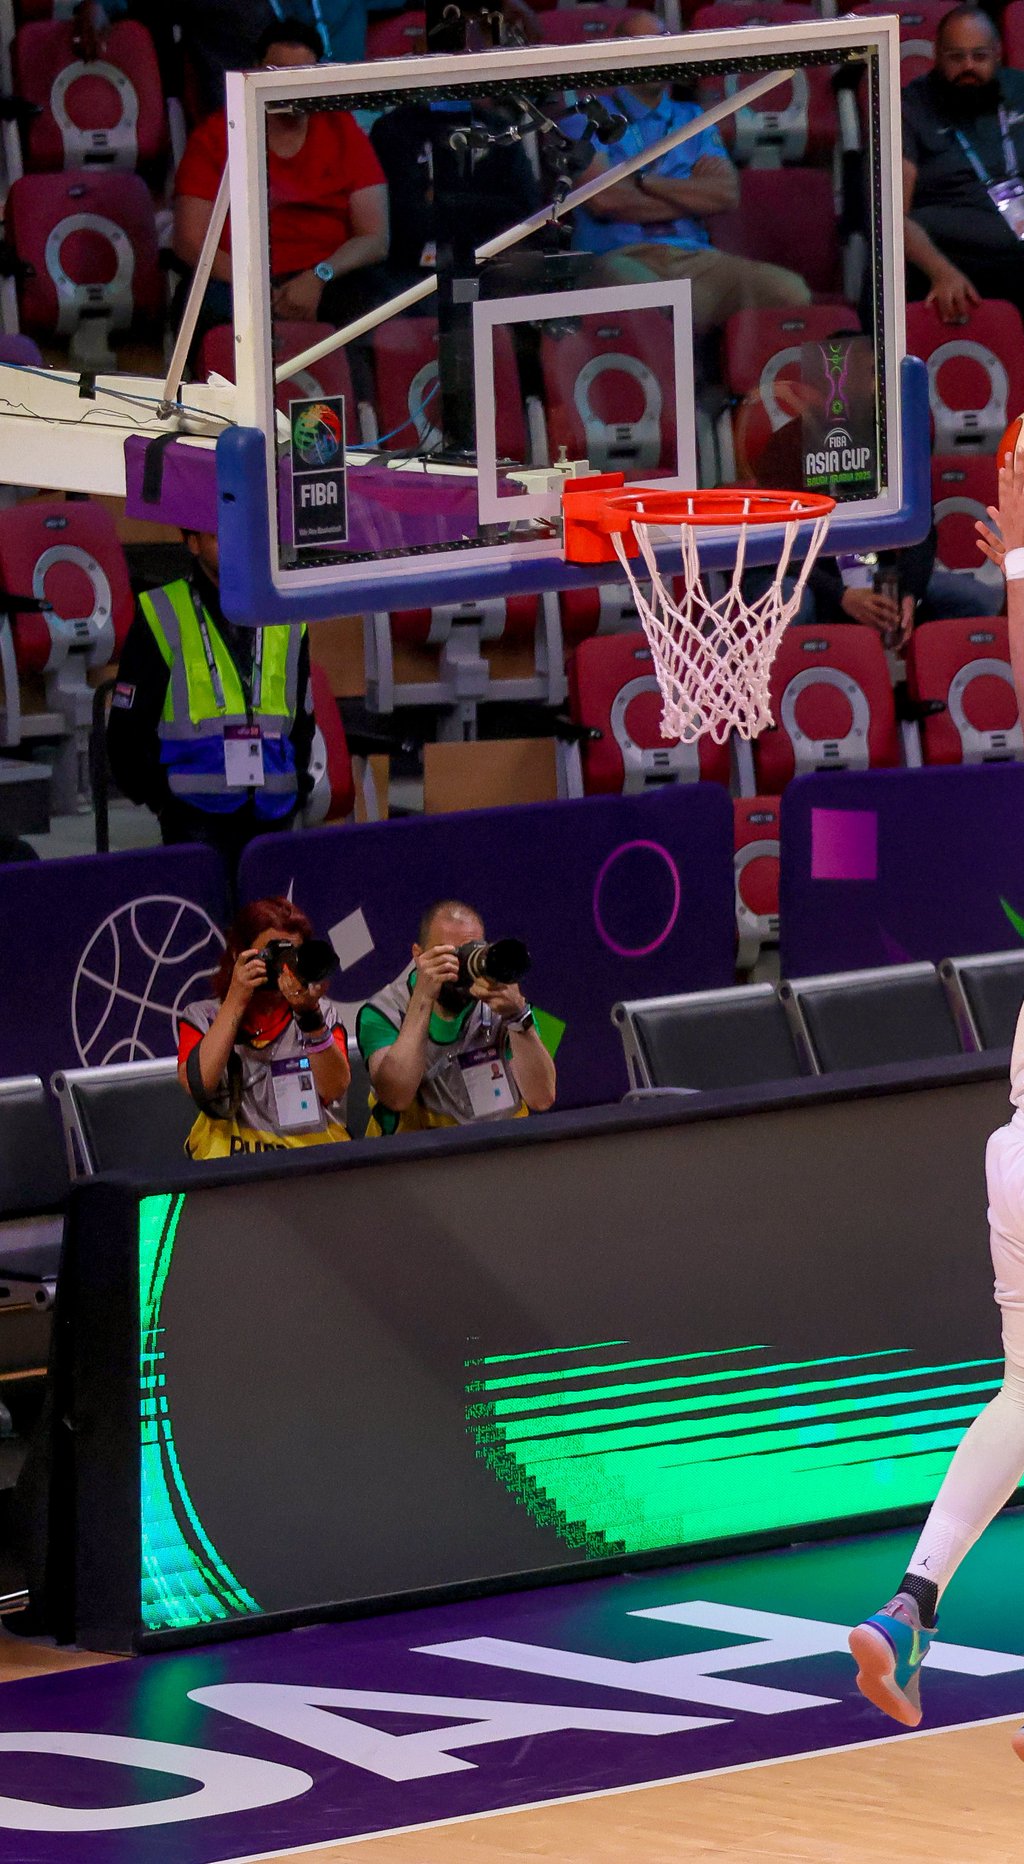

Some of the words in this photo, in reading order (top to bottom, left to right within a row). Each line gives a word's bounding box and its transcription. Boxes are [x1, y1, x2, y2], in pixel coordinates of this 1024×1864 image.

[829, 435, 847, 448] FIBA
[806, 450, 840, 475] ASIA
[841, 447, 871, 471] CUP
[301, 481, 338, 508] FIBA
